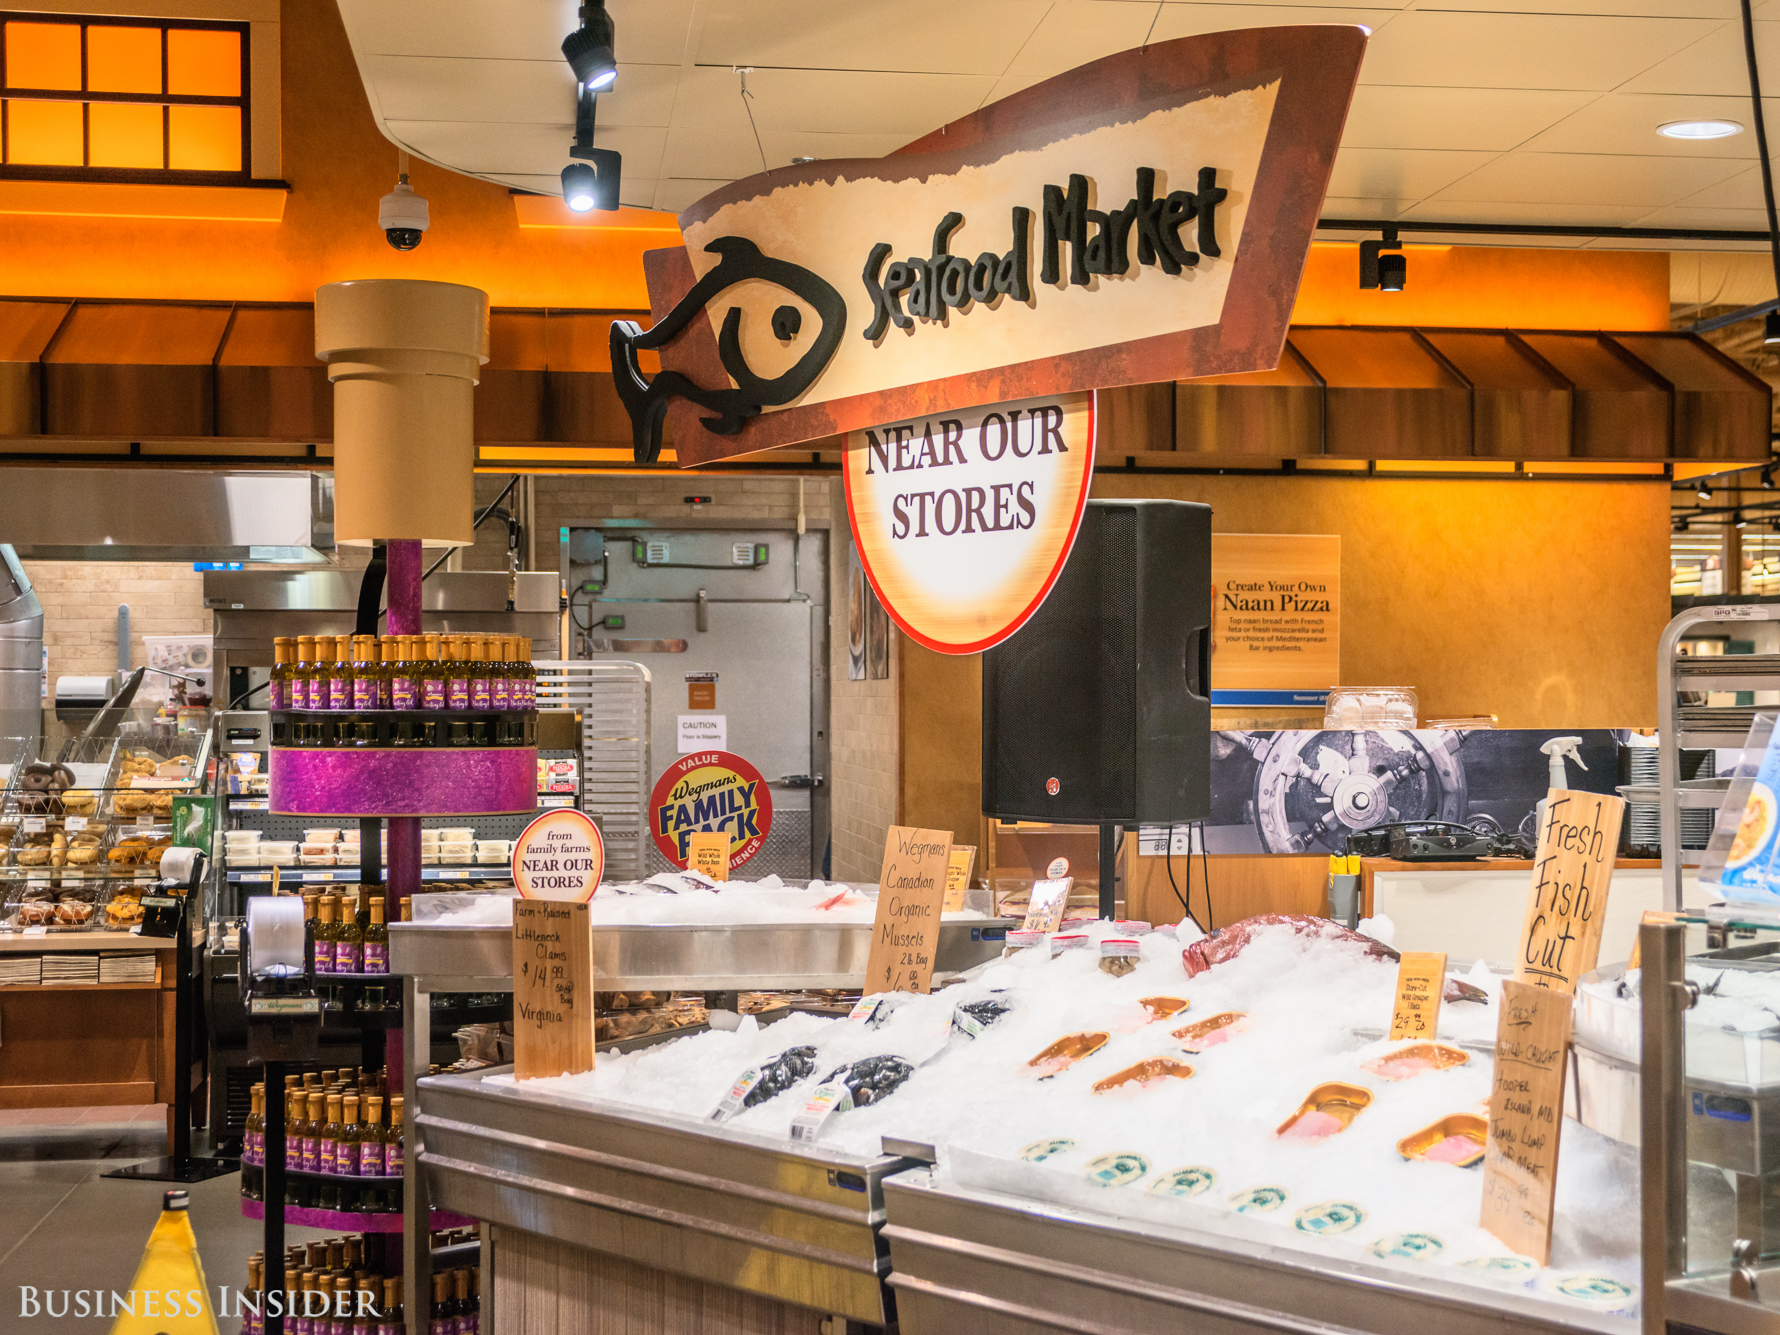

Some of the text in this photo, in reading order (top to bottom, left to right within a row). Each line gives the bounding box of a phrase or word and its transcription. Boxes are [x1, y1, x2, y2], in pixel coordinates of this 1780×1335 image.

[862, 166, 1228, 341] Seafood Market
[865, 404, 1069, 475] NEAR OUR
[892, 480, 1036, 540] STORES
[1226, 580, 1326, 593] Create Your Own
[1222, 593, 1332, 612] Naan Pizza
[1228, 625, 1242, 633] feta
[1252, 625, 1271, 633] fresh
[1311, 626, 1325, 634] and
[1229, 616, 1241, 625] Top
[1262, 617, 1283, 625] bread
[1284, 617, 1299, 625] with
[1301, 617, 1325, 625] French
[1262, 644, 1304, 653] ingredients.
[1275, 635, 1328, 643] Mediterranean
[678, 754, 719, 771] VALUE
[670, 774, 737, 803] Wegmans
[659, 781, 757, 836] FAMILY
[546, 830, 573, 840] from
[1546, 797, 1605, 863] Fresh
[526, 843, 591, 856] family farms
[897, 828, 946, 864] Wegmans
[521, 858, 594, 872] NEAR OUR
[531, 875, 584, 889] STORES
[886, 864, 935, 890] Canadian
[1535, 855, 1592, 922] Fish
[889, 896, 931, 924] Organic
[515, 922, 561, 943] Littleneck
[881, 923, 924, 948] Mussels
[535, 943, 567, 961] Clams
[1526, 915, 1576, 972] Cut
[916, 952, 928, 970] Bag
[268, 999, 303, 1012] Wegmans
[560, 994, 573, 1009] Bag
[1412, 993, 1430, 1002] Grouper
[519, 1002, 563, 1029] Virginia
[1506, 995, 1538, 1021] FRESH
